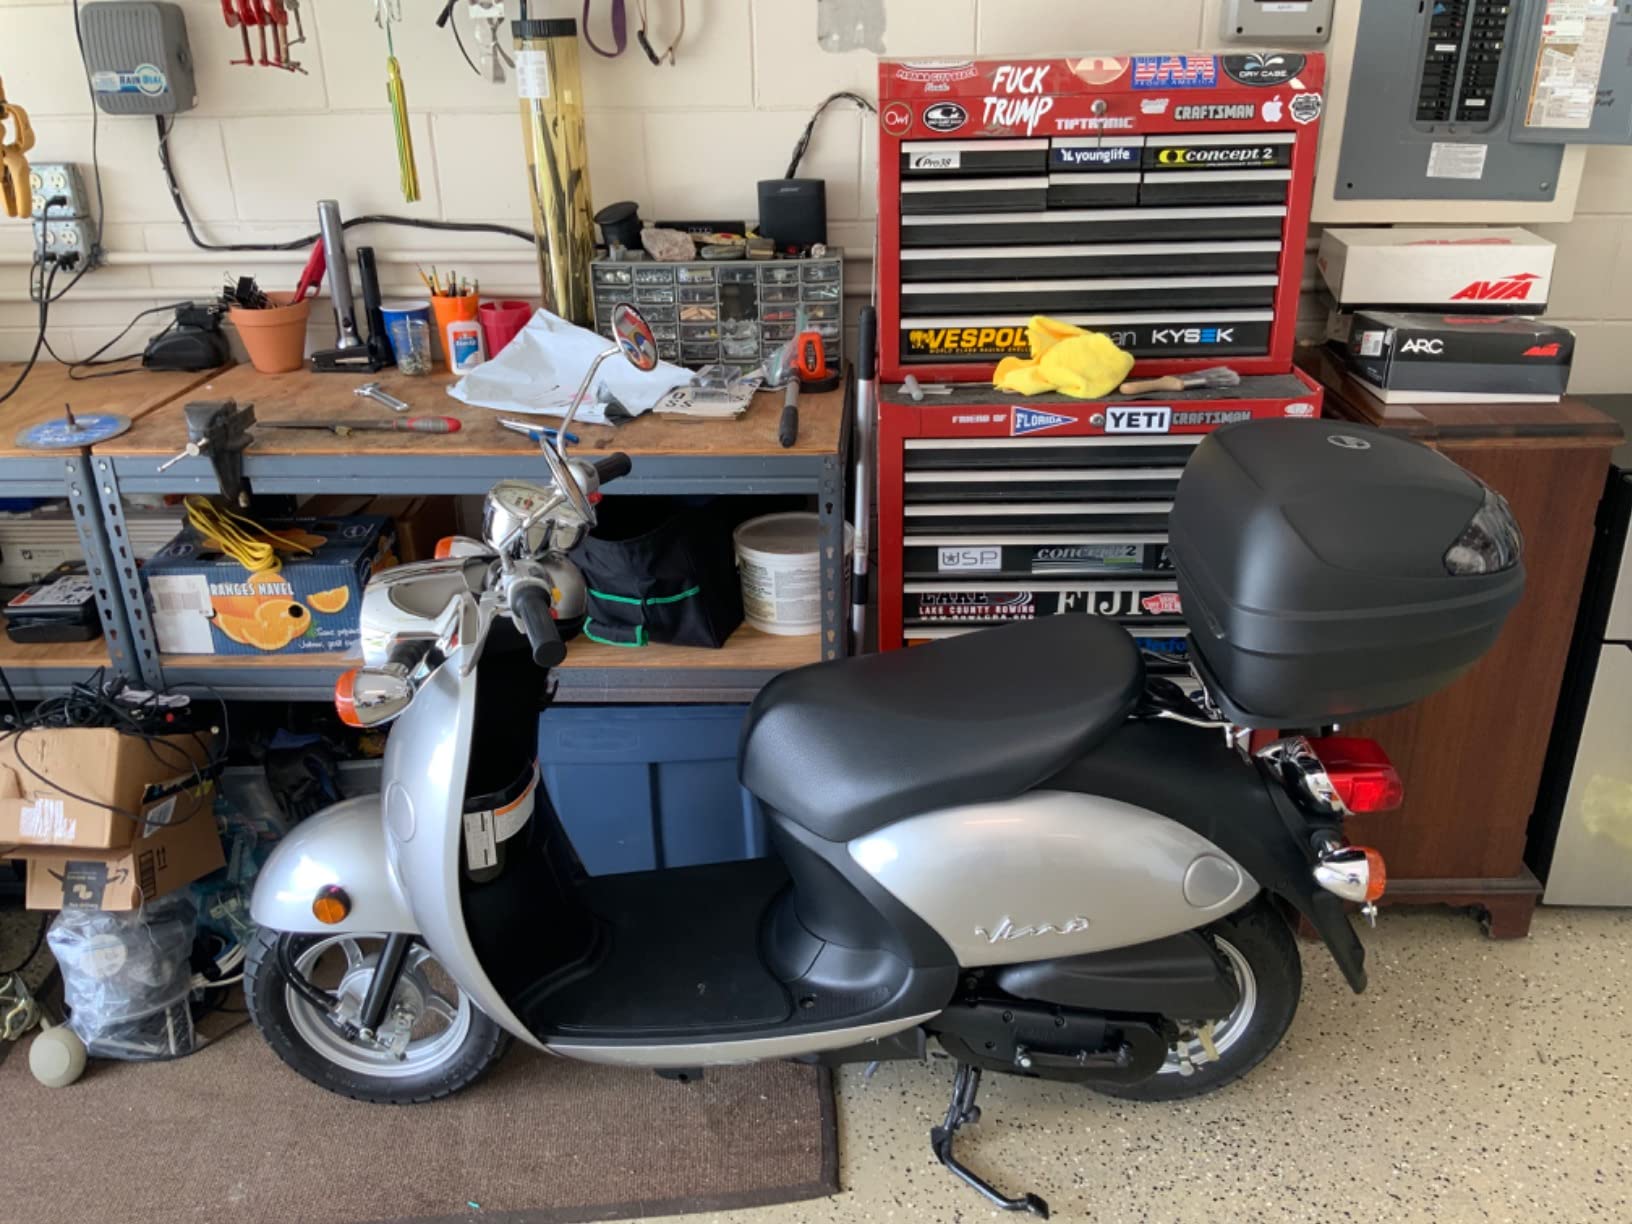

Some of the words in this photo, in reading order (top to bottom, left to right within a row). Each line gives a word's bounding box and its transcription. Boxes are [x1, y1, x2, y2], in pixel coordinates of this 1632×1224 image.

[992, 64, 1050, 94] FUCK
[983, 95, 1053, 136] TRUMP
[1174, 104, 1254, 121] CRAFTSMAN
[1075, 147, 1130, 164] younglife
[1185, 148, 1259, 161] concept
[1263, 147, 1273, 160] 2
[1449, 280, 1532, 300] AVIA
[927, 327, 1029, 349] VESPOL
[1151, 327, 1234, 344] KYSEK
[1400, 338, 1444, 354] ARC
[1016, 413, 1062, 428] FLORIDA
[1110, 412, 1165, 428] YETI
[942, 551, 998, 566] USP
[1125, 545, 1137, 557] 2
[210, 583, 255, 596] RANGES
[258, 582, 295, 596] NAVEL
[919, 605, 944, 615] LAKE
[950, 605, 990, 614] COUNTY
[995, 604, 1035, 614] ROWING
[1054, 591, 1142, 616] FIJI
